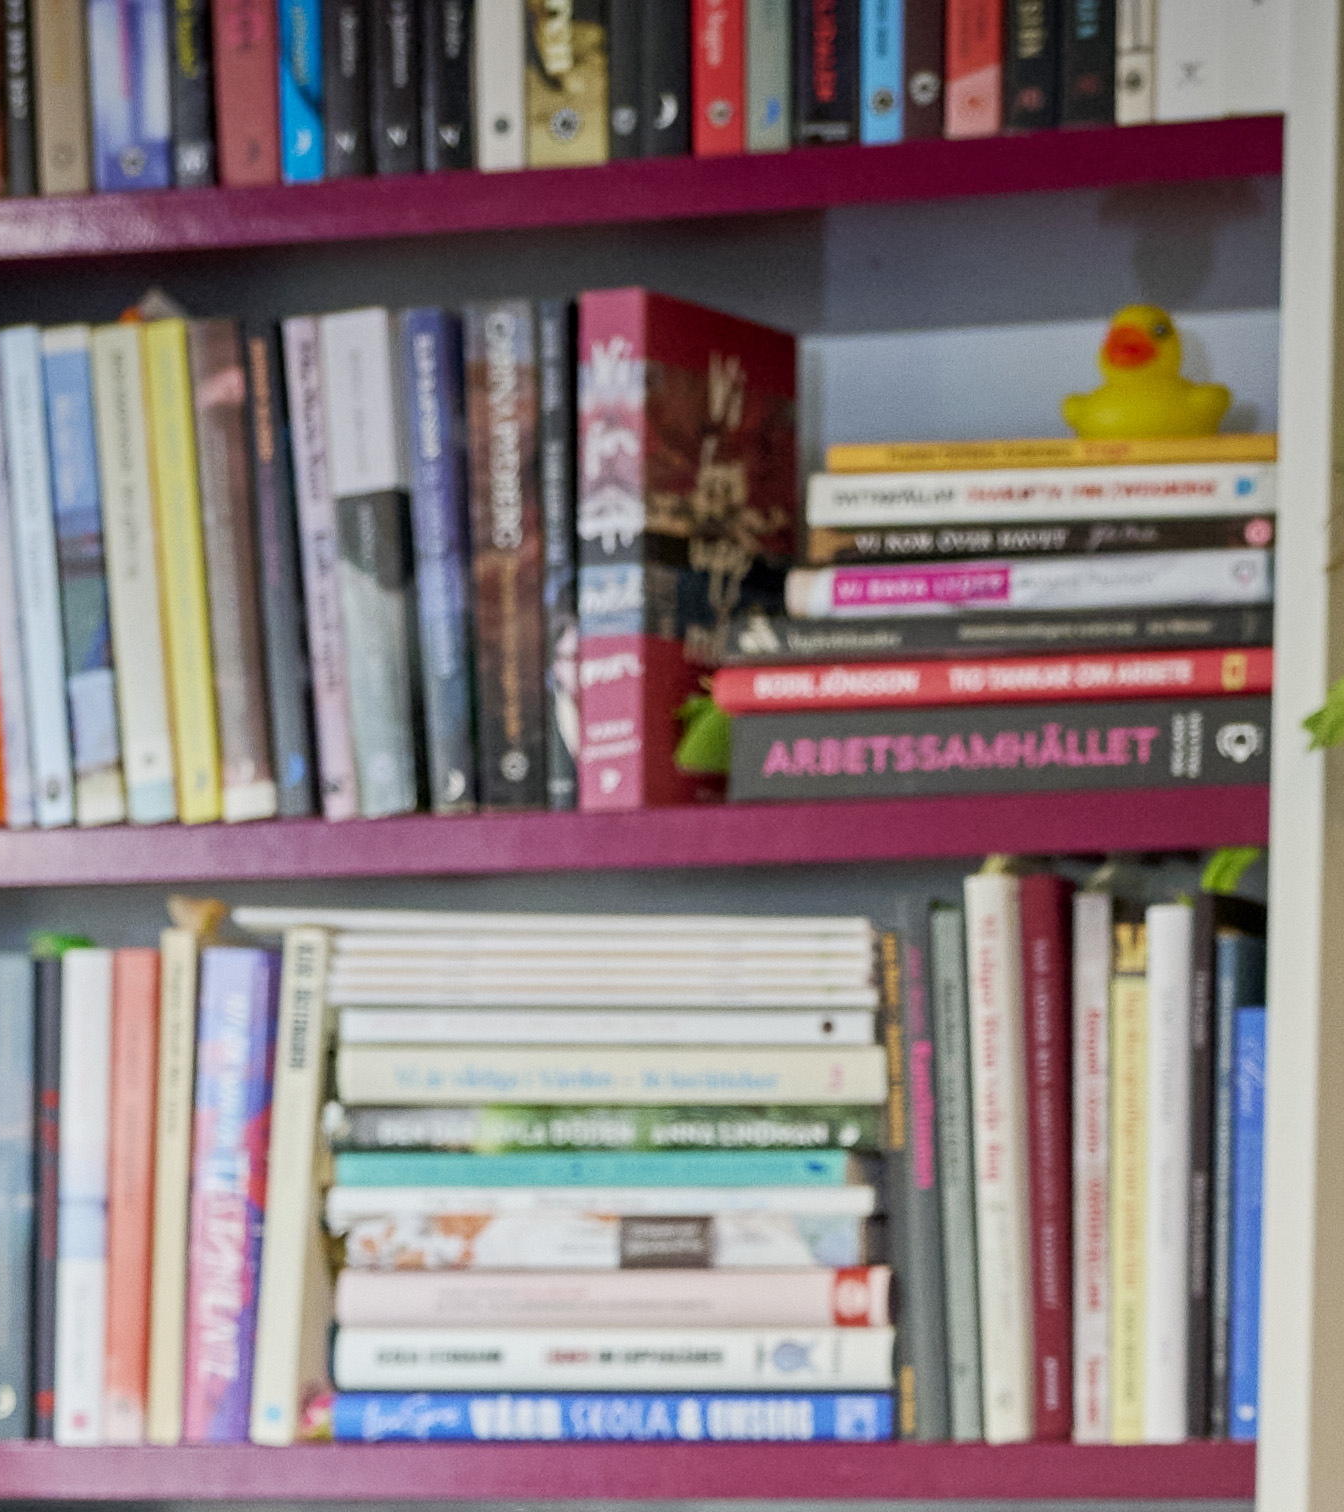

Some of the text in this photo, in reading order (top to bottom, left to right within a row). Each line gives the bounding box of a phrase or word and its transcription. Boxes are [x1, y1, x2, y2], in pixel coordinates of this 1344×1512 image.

[1077, 663, 1113, 687] OM
[1115, 660, 1194, 686] ARBETE
[762, 724, 1158, 777] ARBETSSAMHÄLLET
[568, 1396, 672, 1441] SKOLA
